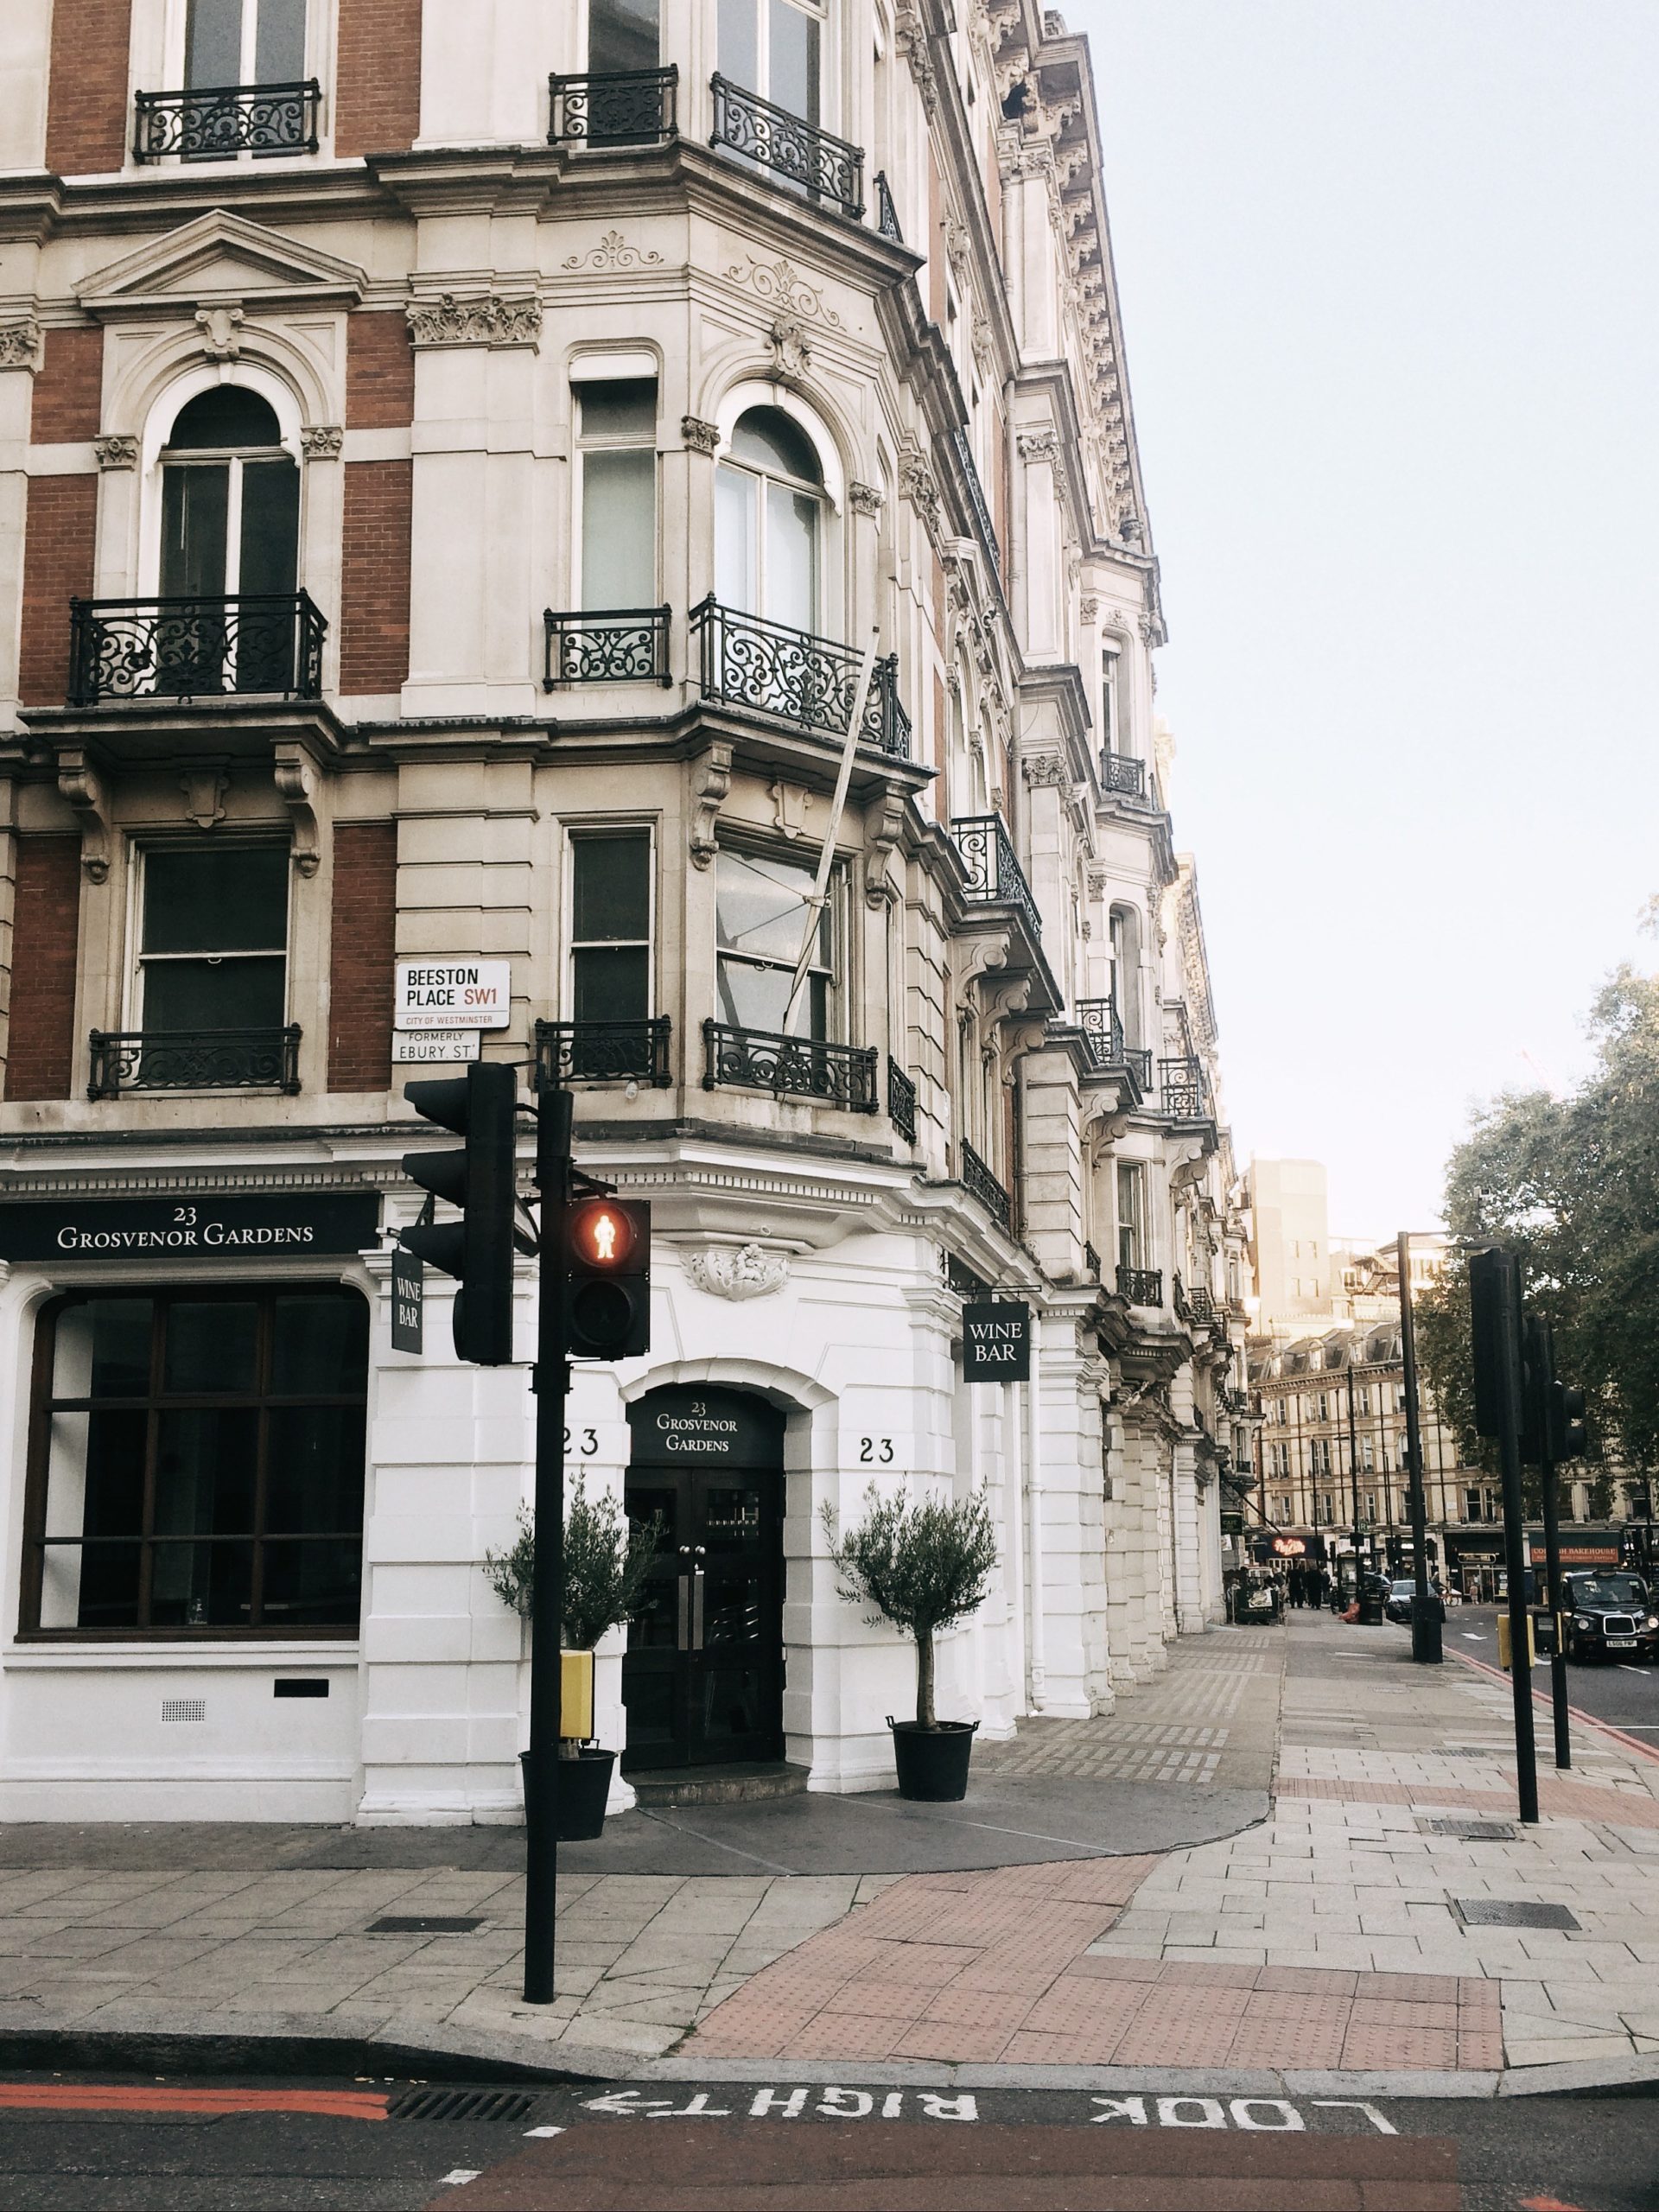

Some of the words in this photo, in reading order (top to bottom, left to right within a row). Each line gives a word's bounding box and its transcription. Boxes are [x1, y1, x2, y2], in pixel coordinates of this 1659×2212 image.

[408, 968, 479, 986] BEESTON
[407, 988, 455, 1006] PLACE
[464, 988, 497, 1005] SW1
[437, 1015, 493, 1025] WESTMINSTER
[174, 1207, 197, 1226] 23
[397, 1277, 421, 1302] WINE
[399, 1304, 418, 1328] BAR
[969, 1322, 1023, 1340] WINE
[975, 1344, 1017, 1362] BAR
[691, 1402, 706, 1417] 23
[860, 1437, 893, 1463] 23
[645, 2087, 980, 2121] RIGHT
[1090, 2096, 1400, 2135] LOOK
